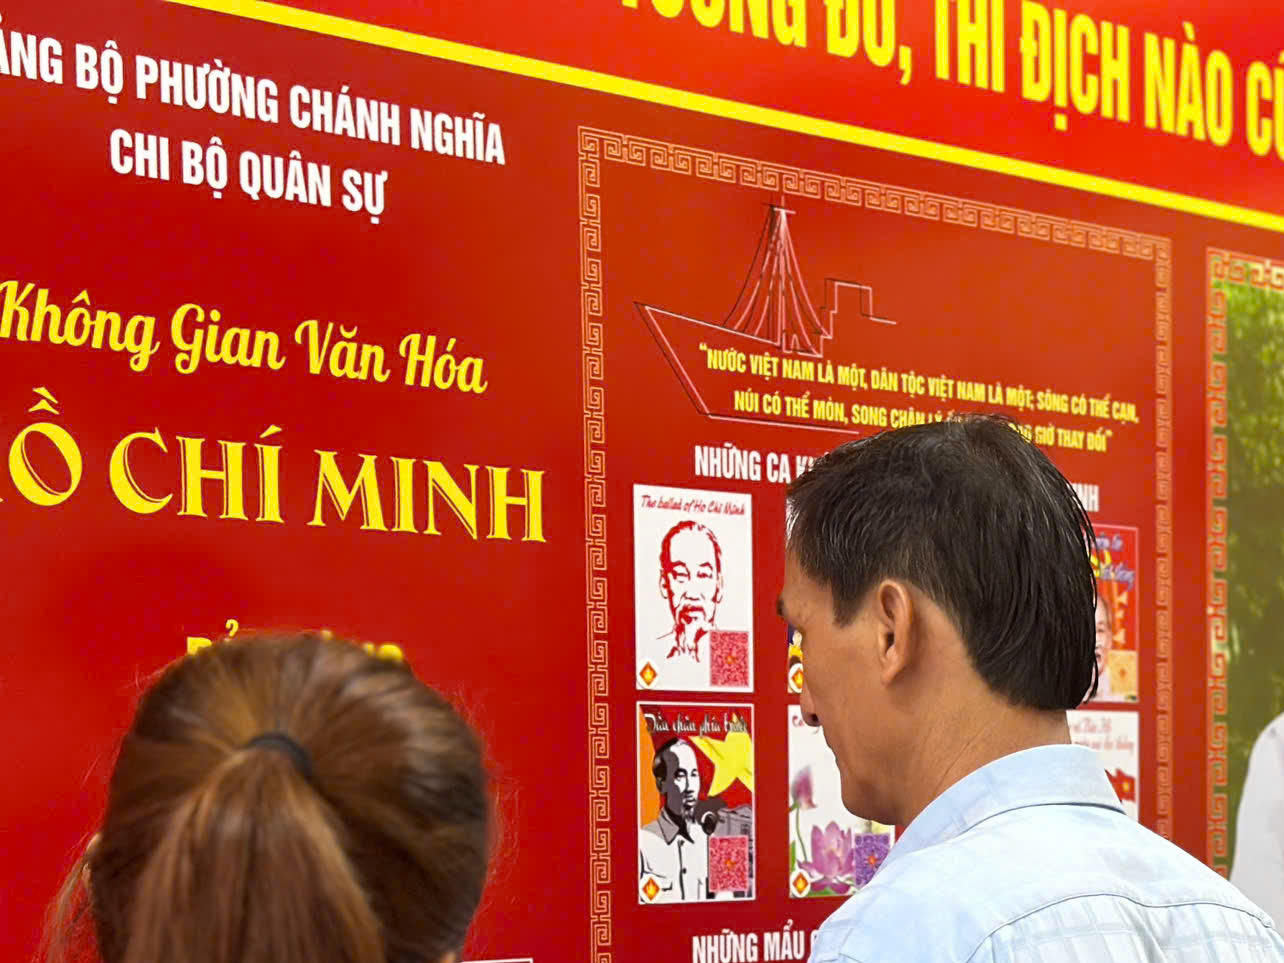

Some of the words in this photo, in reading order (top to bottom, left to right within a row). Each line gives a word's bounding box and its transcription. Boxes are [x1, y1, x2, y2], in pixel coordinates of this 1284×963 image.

[75, 40, 123, 104] BỘ
[136, 55, 278, 123] PHƯỜNG
[290, 84, 400, 146] CHÁNH
[410, 112, 505, 165] NGHĨA
[1020, 0, 1129, 131] ĐỊCH
[1145, 20, 1233, 147] NÀO
[110, 129, 169, 181] CHI
[181, 136, 228, 199] BỘ
[239, 150, 332, 208] QUÂN
[342, 168, 389, 225] SỰ
[0, 280, 160, 372] Không
[170, 303, 286, 374] Gian
[294, 319, 390, 383] Văn
[399, 334, 488, 394] Hóa
[750, 352, 779, 381] VIỆT
[782, 359, 815, 381] NAM
[818, 360, 834, 384] LÀ
[837, 363, 868, 391] MỘT,
[871, 367, 899, 392] DÂN
[901, 370, 925, 398] TỘC
[928, 374, 955, 401] VIỆT
[957, 381, 985, 403] NAM
[988, 381, 1003, 405] LÀ
[1036, 388, 1069, 414] SÔNG
[1071, 394, 1087, 415] CÓ
[5, 387, 83, 506] Ồ
[109, 425, 284, 523] CHÍ
[307, 449, 545, 541] MINH
[694, 442, 762, 482] NHỮNG
[766, 452, 792, 484] CA
[734, 387, 759, 413] NÚI
[763, 391, 781, 415] CÓ
[784, 390, 810, 418] THỂ
[851, 404, 888, 427] SONG
[1058, 428, 1084, 450] THAY
[764, 920, 805, 962] MẨU
